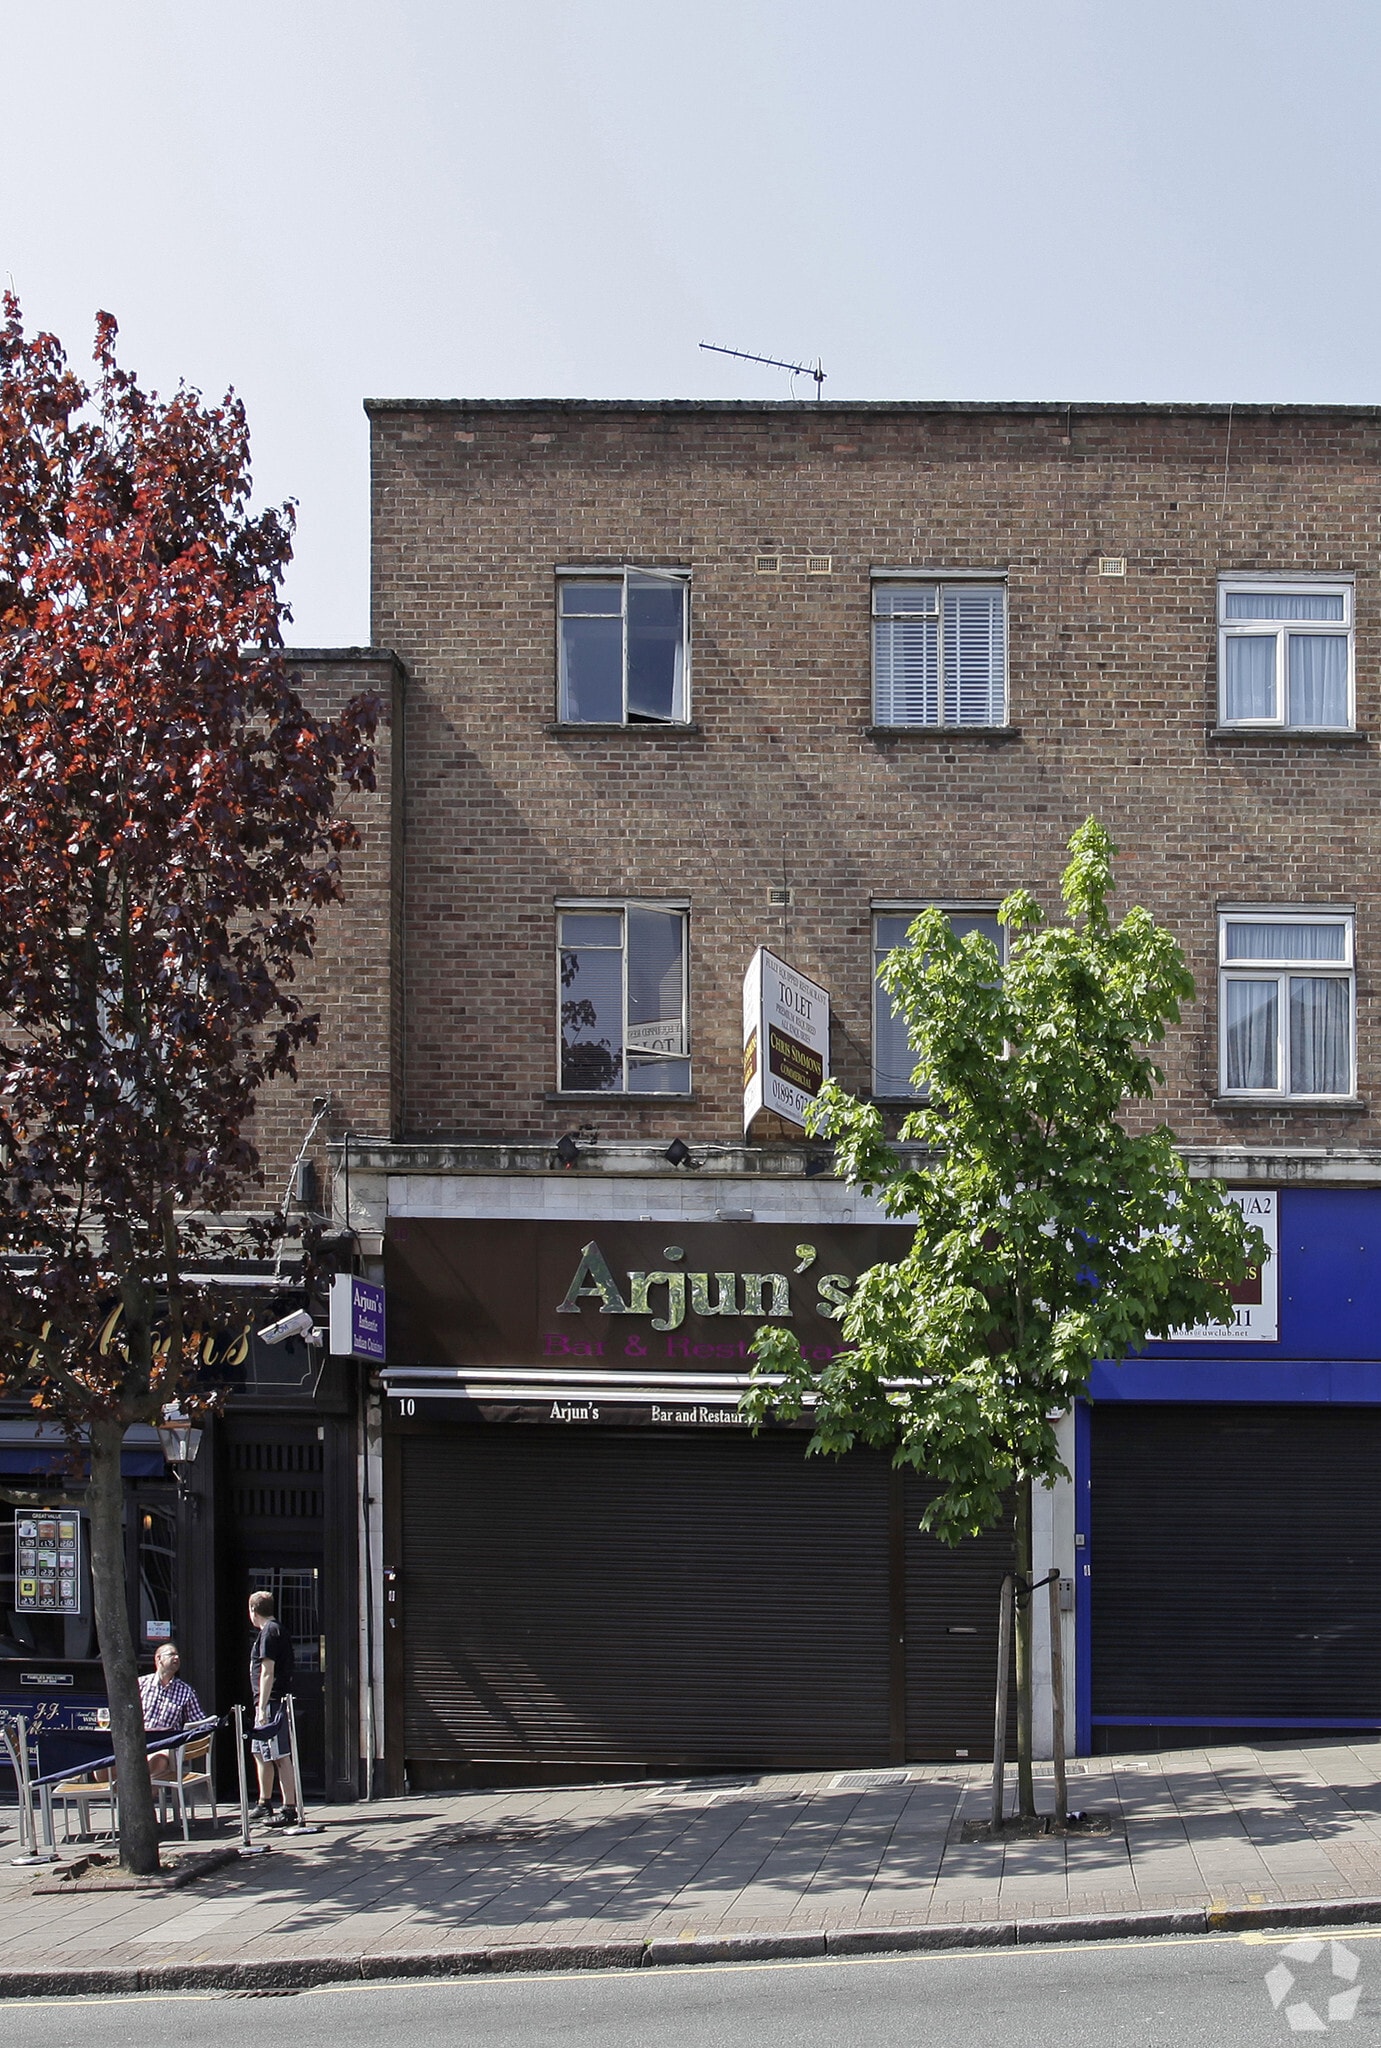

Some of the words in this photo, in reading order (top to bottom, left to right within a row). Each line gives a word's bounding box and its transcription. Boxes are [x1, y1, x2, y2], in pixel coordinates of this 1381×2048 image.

[779, 981, 793, 1008] TO
[794, 992, 813, 1021] LET
[791, 1044, 822, 1076] SIMMONS
[780, 1062, 812, 1089] COMMERCIAL
[772, 1079, 794, 1107] 01895
[556, 1240, 852, 1331] Arjun's
[353, 1287, 383, 1314] Arjun's
[353, 1333, 368, 1350] Indian
[367, 1337, 383, 1353] Cuisine
[542, 1333, 607, 1356] Bar
[623, 1334, 648, 1356] &
[399, 1398, 415, 1416] 10
[550, 1401, 599, 1423] Arjun's
[651, 1405, 673, 1421] Bar
[675, 1406, 697, 1423] and
